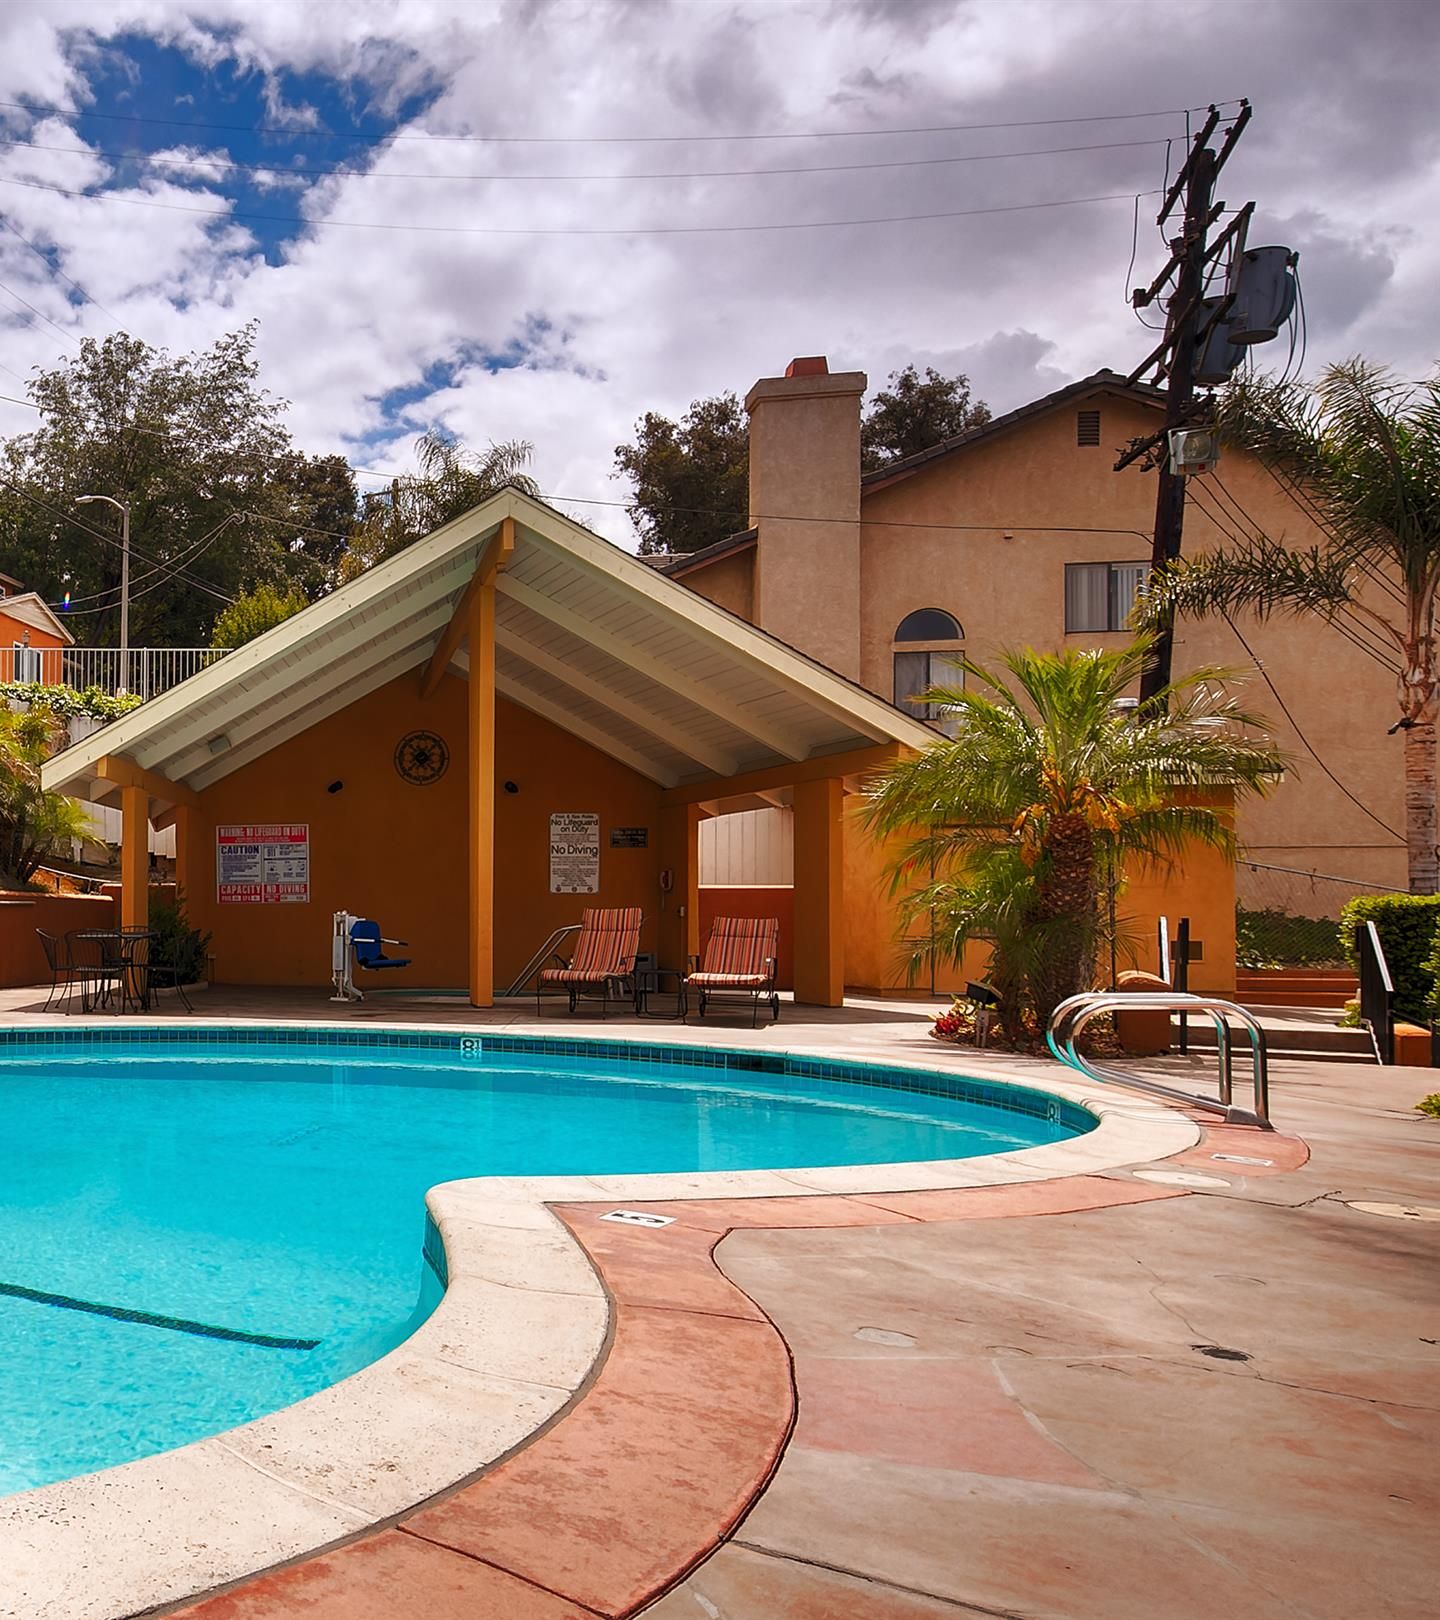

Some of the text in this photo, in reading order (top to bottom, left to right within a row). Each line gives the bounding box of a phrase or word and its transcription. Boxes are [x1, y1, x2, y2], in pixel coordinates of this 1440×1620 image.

[563, 819, 598, 828] Lifeguard
[572, 826, 589, 834] Duty
[221, 845, 260, 855] CAUTION
[551, 844, 598, 859] No Diving
[221, 885, 260, 894] CAPACITY
[266, 884, 305, 893] NO DIVING
